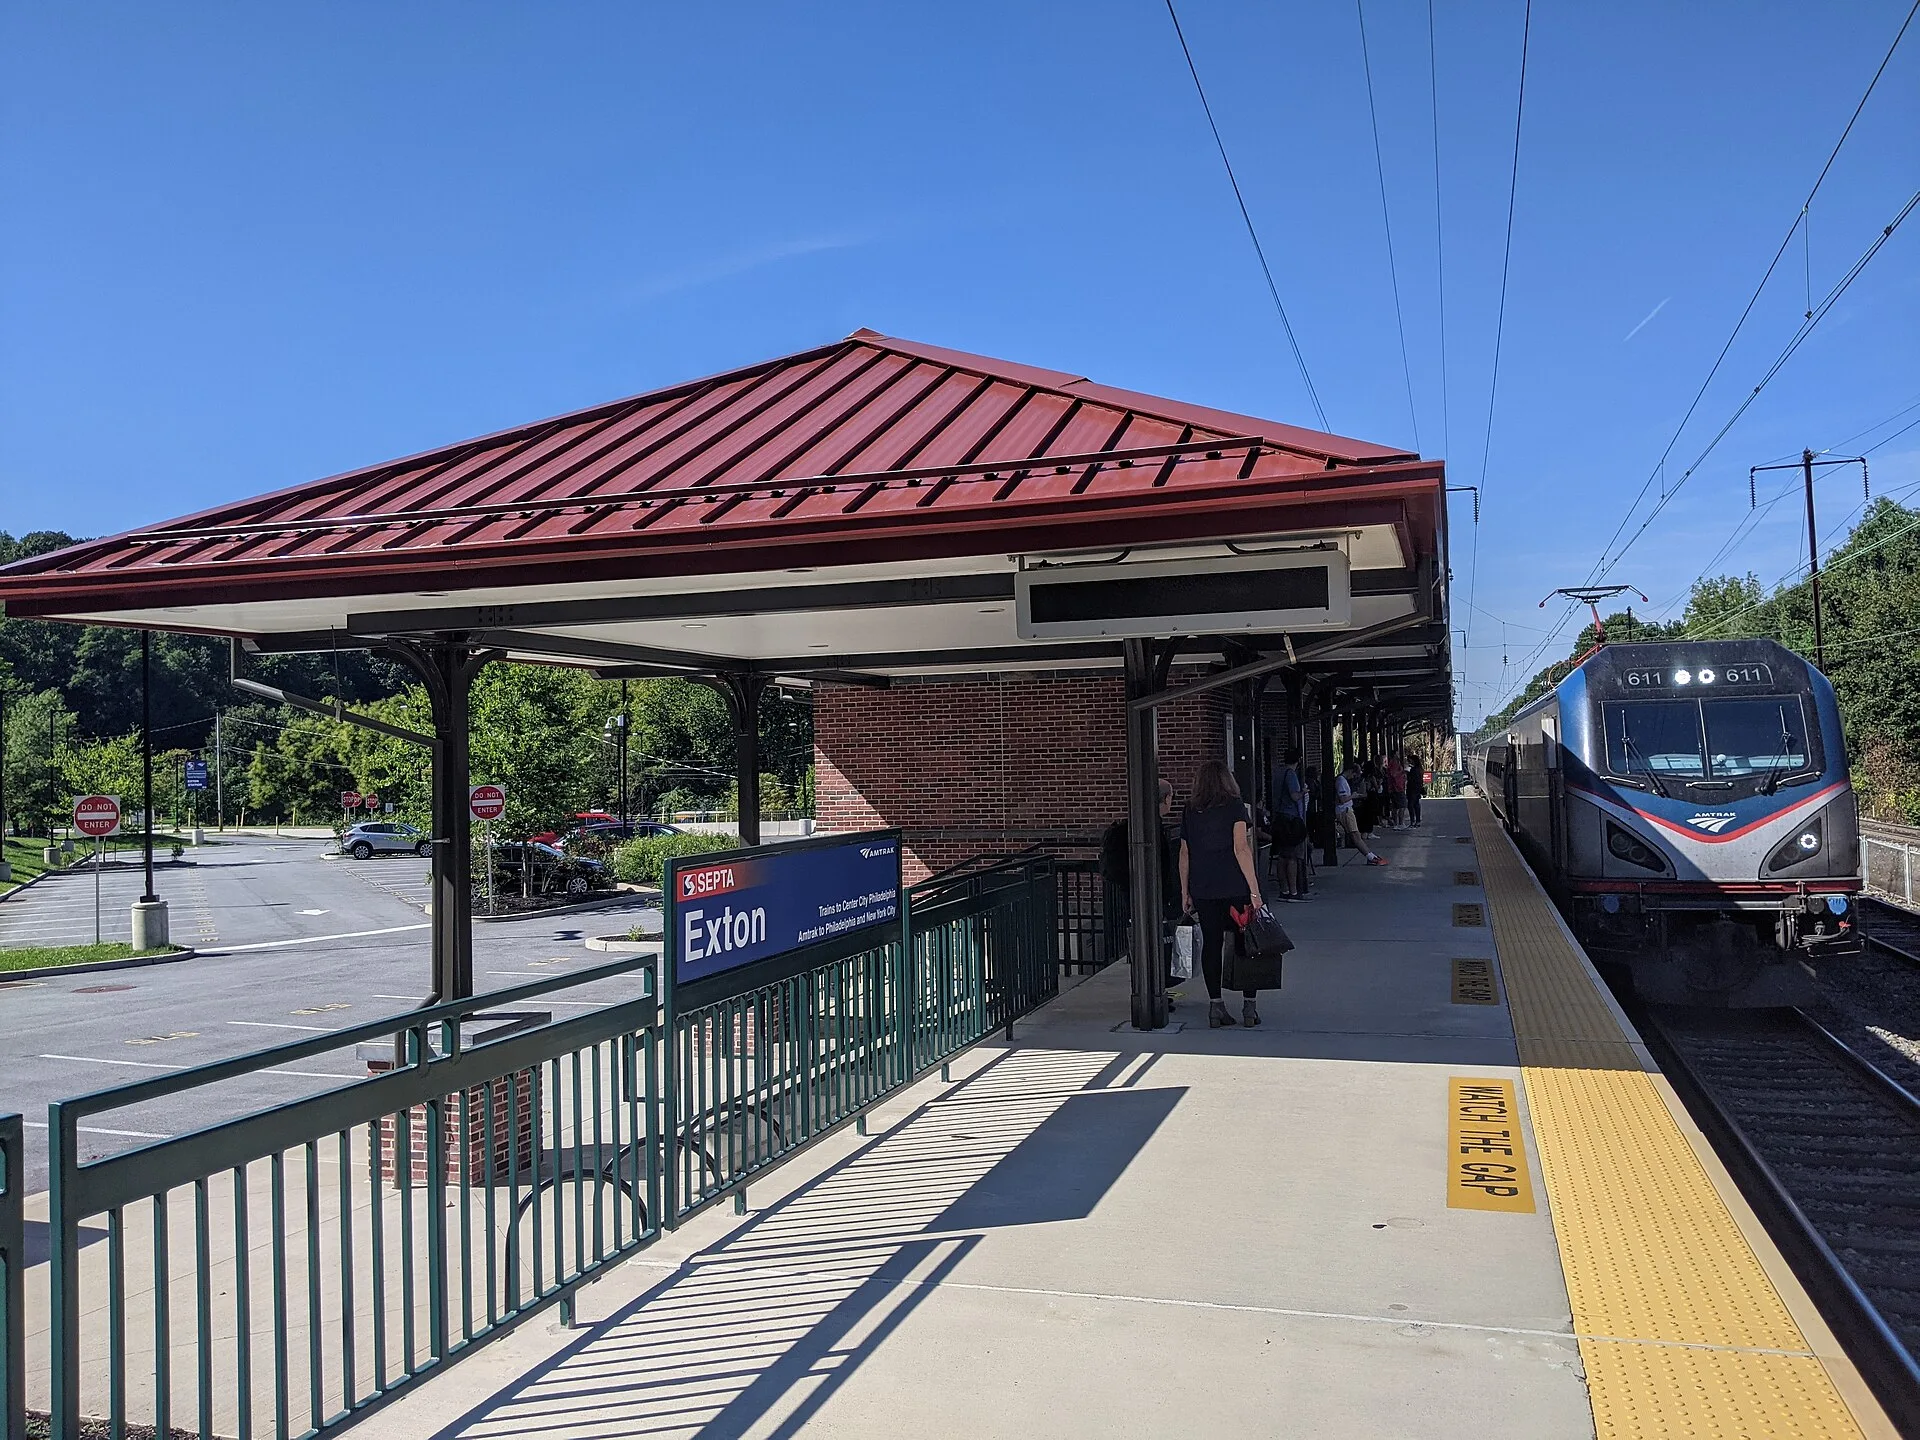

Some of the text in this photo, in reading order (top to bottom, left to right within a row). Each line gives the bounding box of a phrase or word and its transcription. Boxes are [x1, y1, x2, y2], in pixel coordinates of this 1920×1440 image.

[1628, 672, 1661, 685] 611
[1726, 667, 1761, 682] 611
[477, 806, 498, 814] ENTER
[84, 821, 110, 829] ENTER
[869, 846, 895, 857] AMTRAK
[697, 868, 735, 893] SEPTA
[818, 888, 896, 917] Trains to Center City Philadelphia
[798, 905, 896, 943] Amtrak to Philadelphia and New York City
[685, 906, 766, 963] Exton
[1459, 1085, 1519, 1197] WATCH THE GAP
